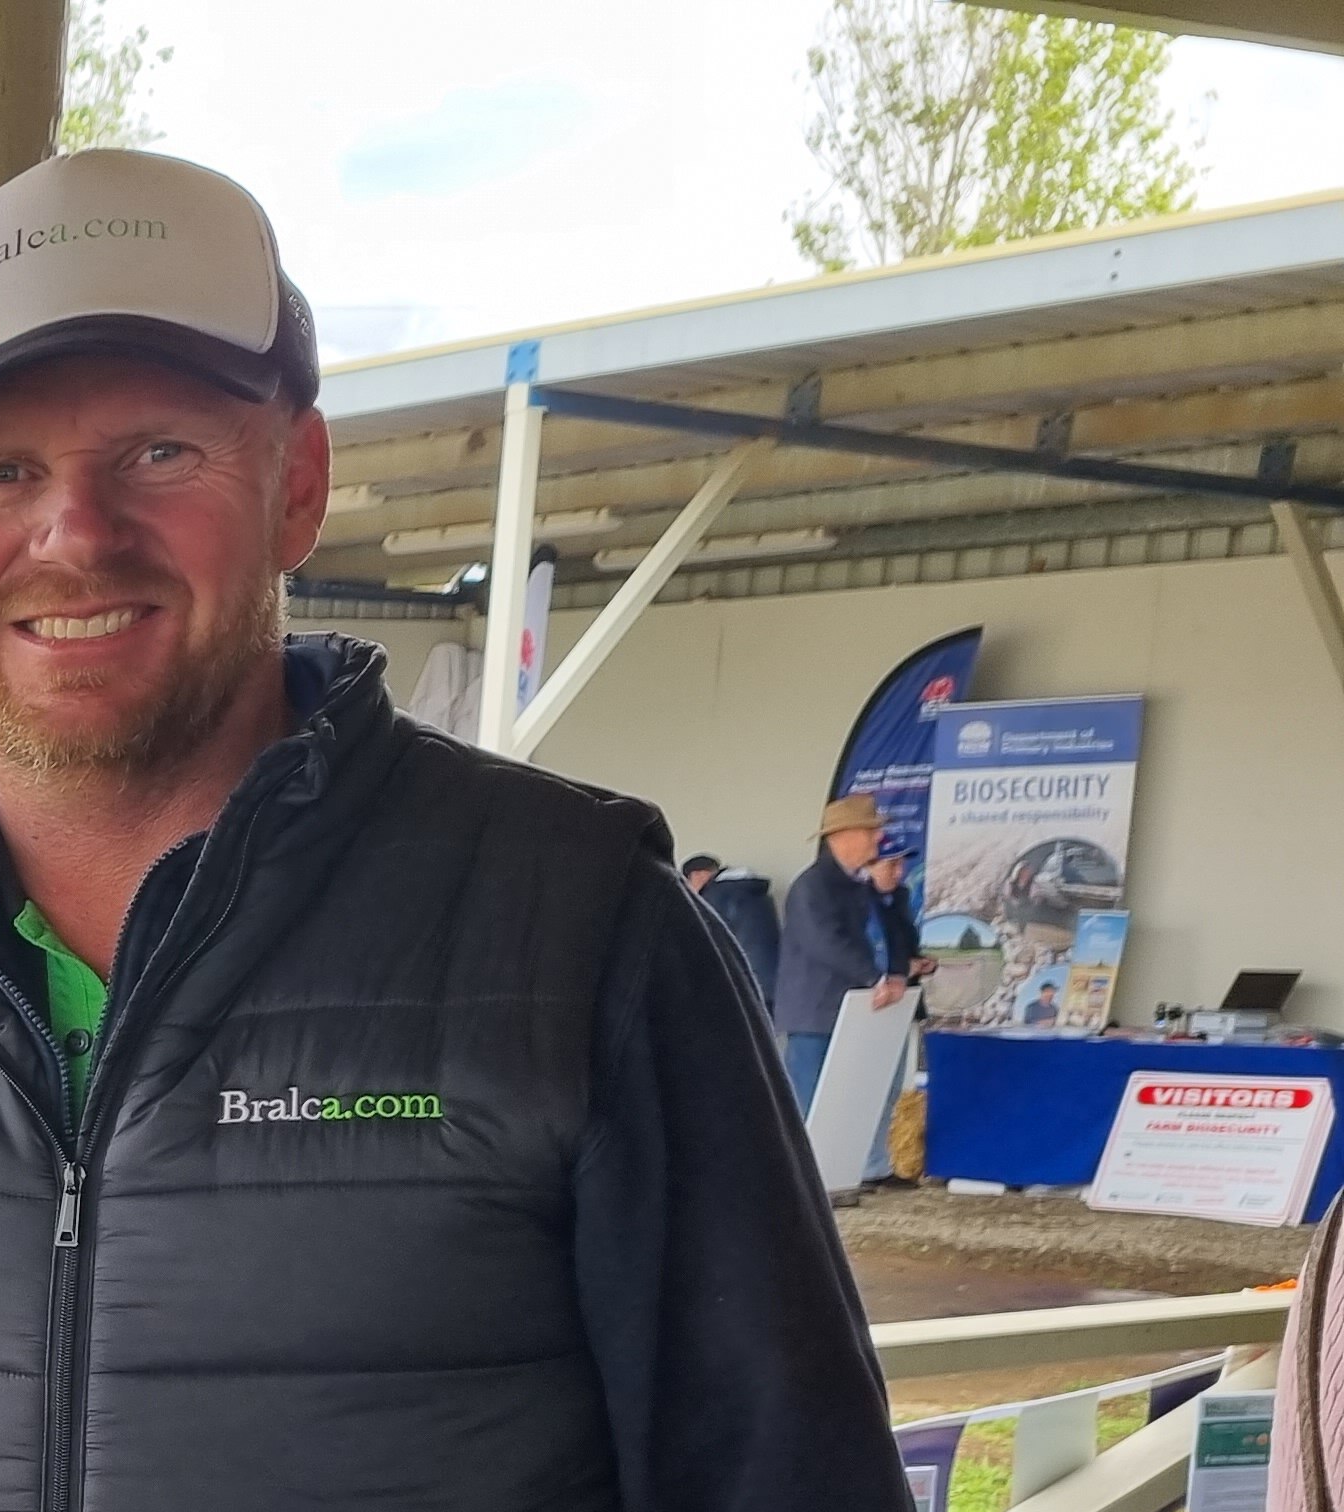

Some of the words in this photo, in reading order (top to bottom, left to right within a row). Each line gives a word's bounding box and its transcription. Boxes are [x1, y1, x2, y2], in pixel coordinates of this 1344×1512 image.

[954, 774, 1110, 804] BIOSECURITY
[217, 1087, 444, 1125] Bralca.com
[1152, 1086, 1295, 1108] VISITORS
